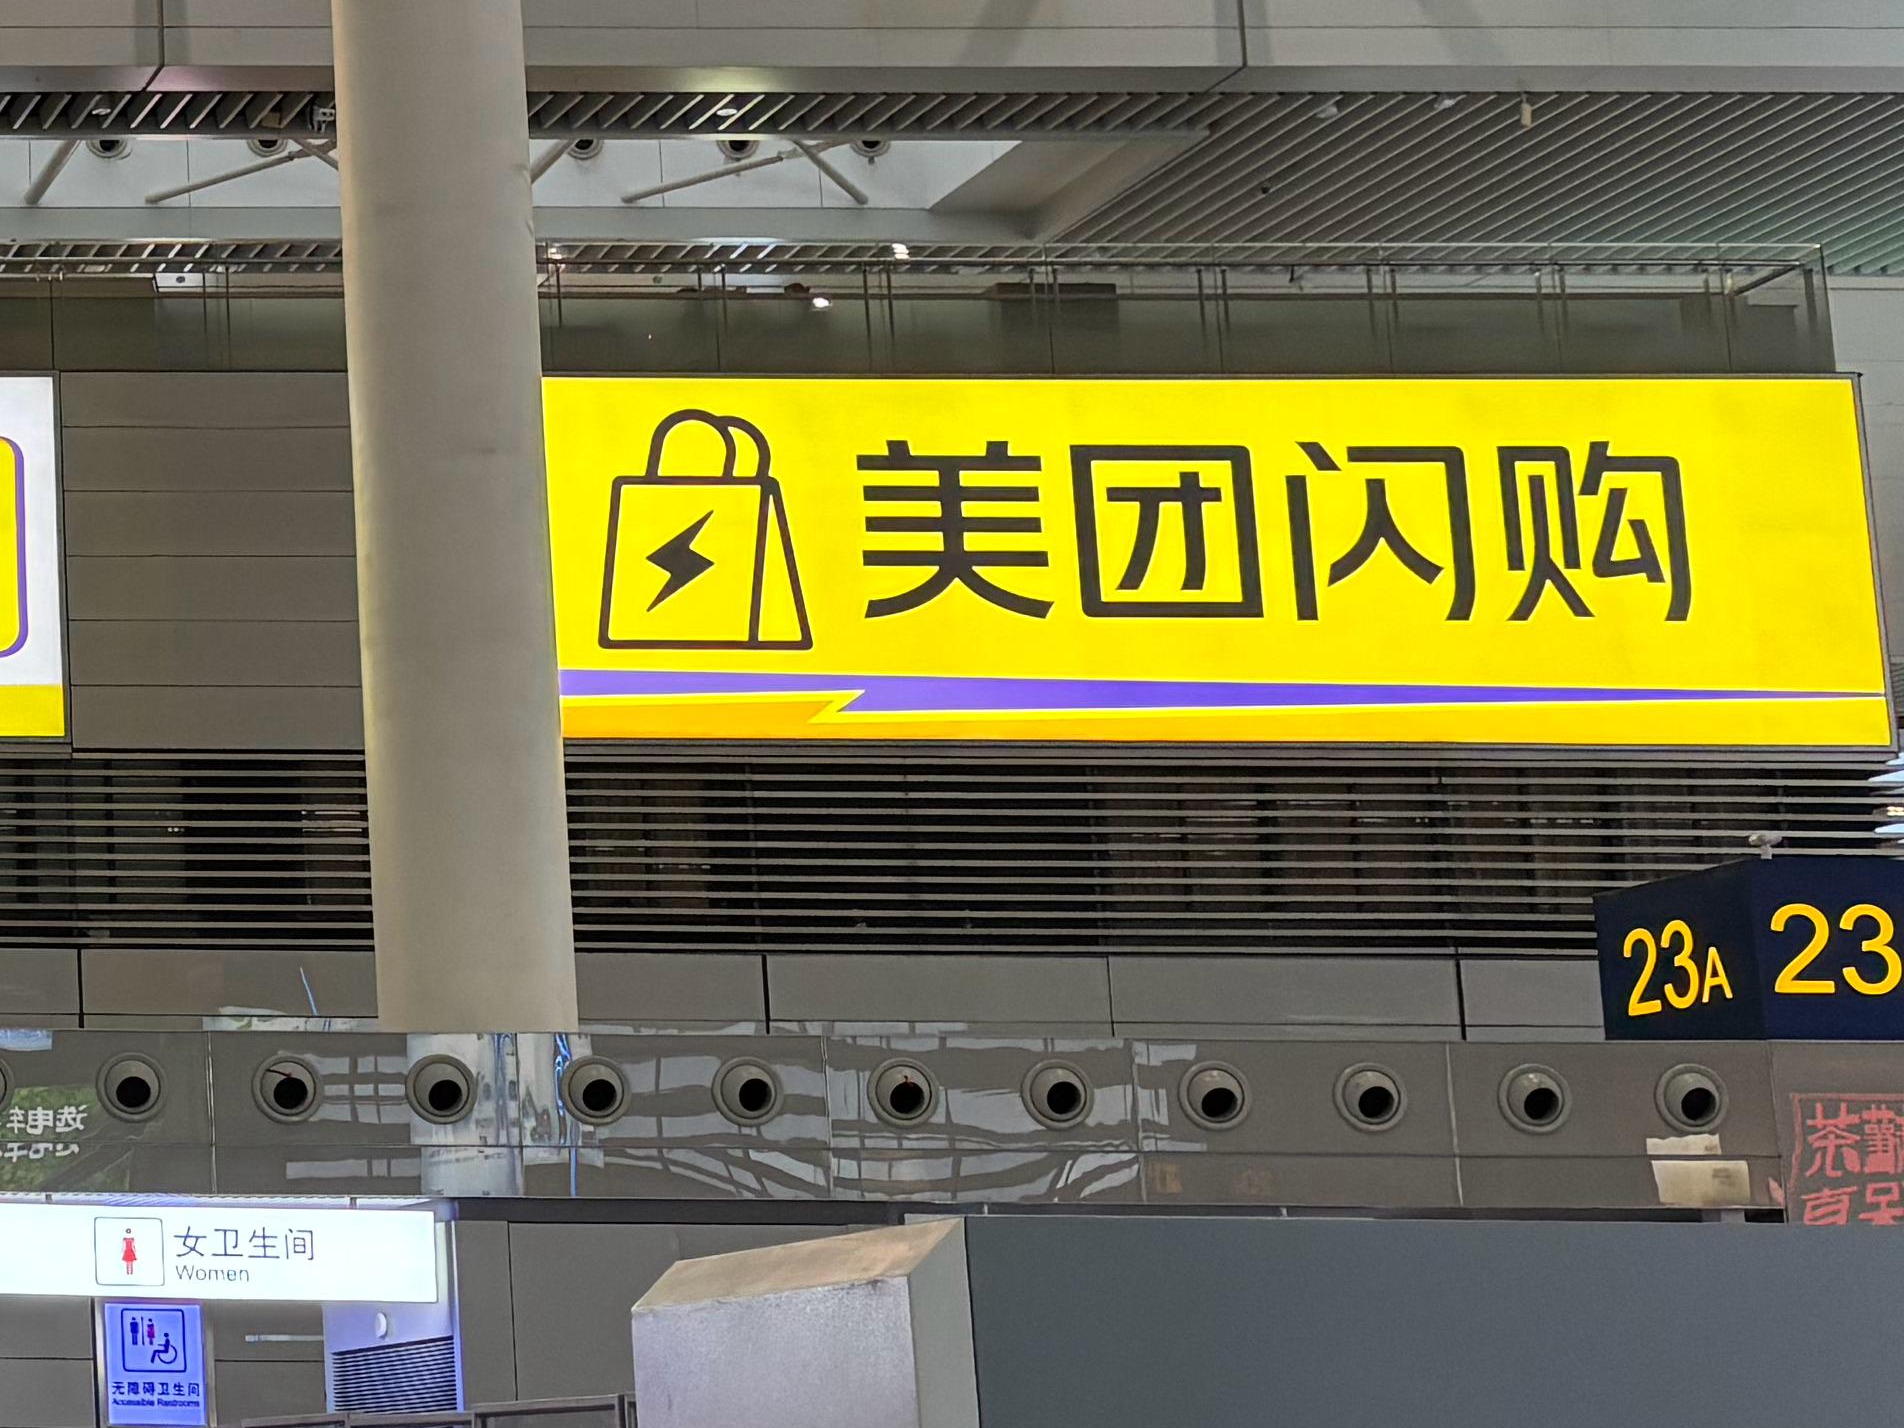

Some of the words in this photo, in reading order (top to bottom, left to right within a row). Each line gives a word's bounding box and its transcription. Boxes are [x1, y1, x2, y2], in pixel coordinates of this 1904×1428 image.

[856, 440, 1690, 623] 美团闪购
[1622, 919, 1734, 1017] 23A
[174, 1228, 316, 1262] 女卫生间
[175, 1264, 250, 1284] Women
